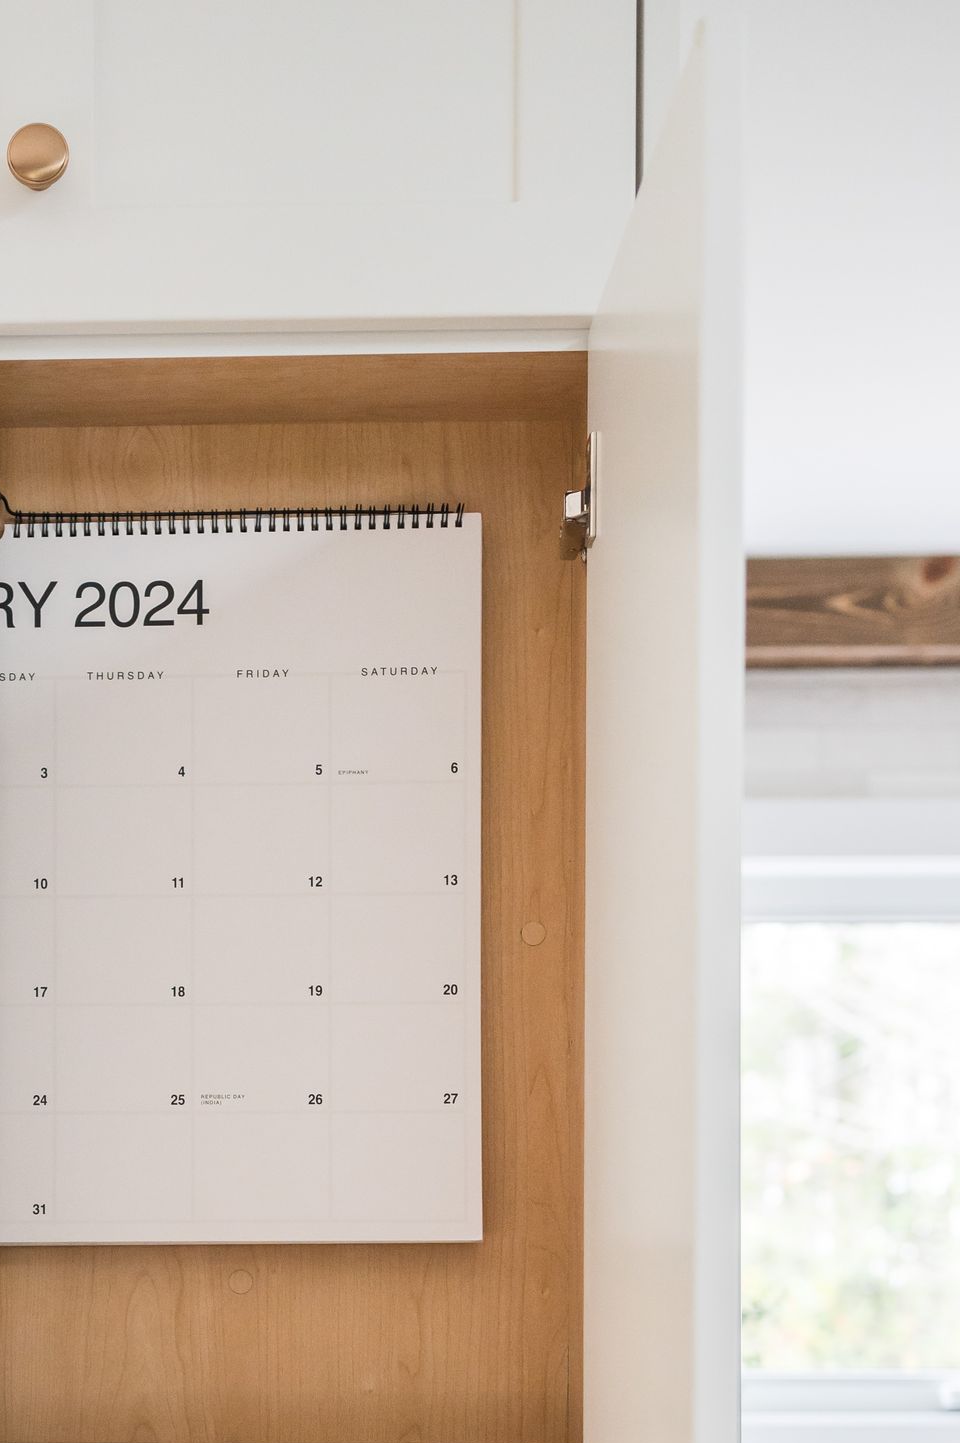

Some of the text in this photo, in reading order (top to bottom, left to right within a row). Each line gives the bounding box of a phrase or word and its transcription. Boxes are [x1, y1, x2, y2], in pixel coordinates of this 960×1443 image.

[74, 579, 210, 628] 2024
[86, 671, 164, 681] THURSDAY
[236, 669, 289, 679] FRIDAY
[361, 666, 438, 677] SATURDAY
[40, 767, 48, 779] 3
[177, 766, 186, 777] 4
[315, 764, 323, 776] 5
[450, 761, 459, 774] 6
[33, 878, 48, 890] 10
[171, 877, 185, 889] 11
[308, 875, 323, 888] 12
[443, 874, 458, 886] 13
[33, 986, 48, 998] 17
[171, 985, 186, 998] 18
[308, 984, 323, 997] 19
[443, 983, 458, 996] 20
[32, 1094, 48, 1106] 24
[170, 1094, 186, 1106] 25
[308, 1093, 323, 1105] 26
[443, 1092, 459, 1105] 27
[32, 1203, 47, 1216] 31
